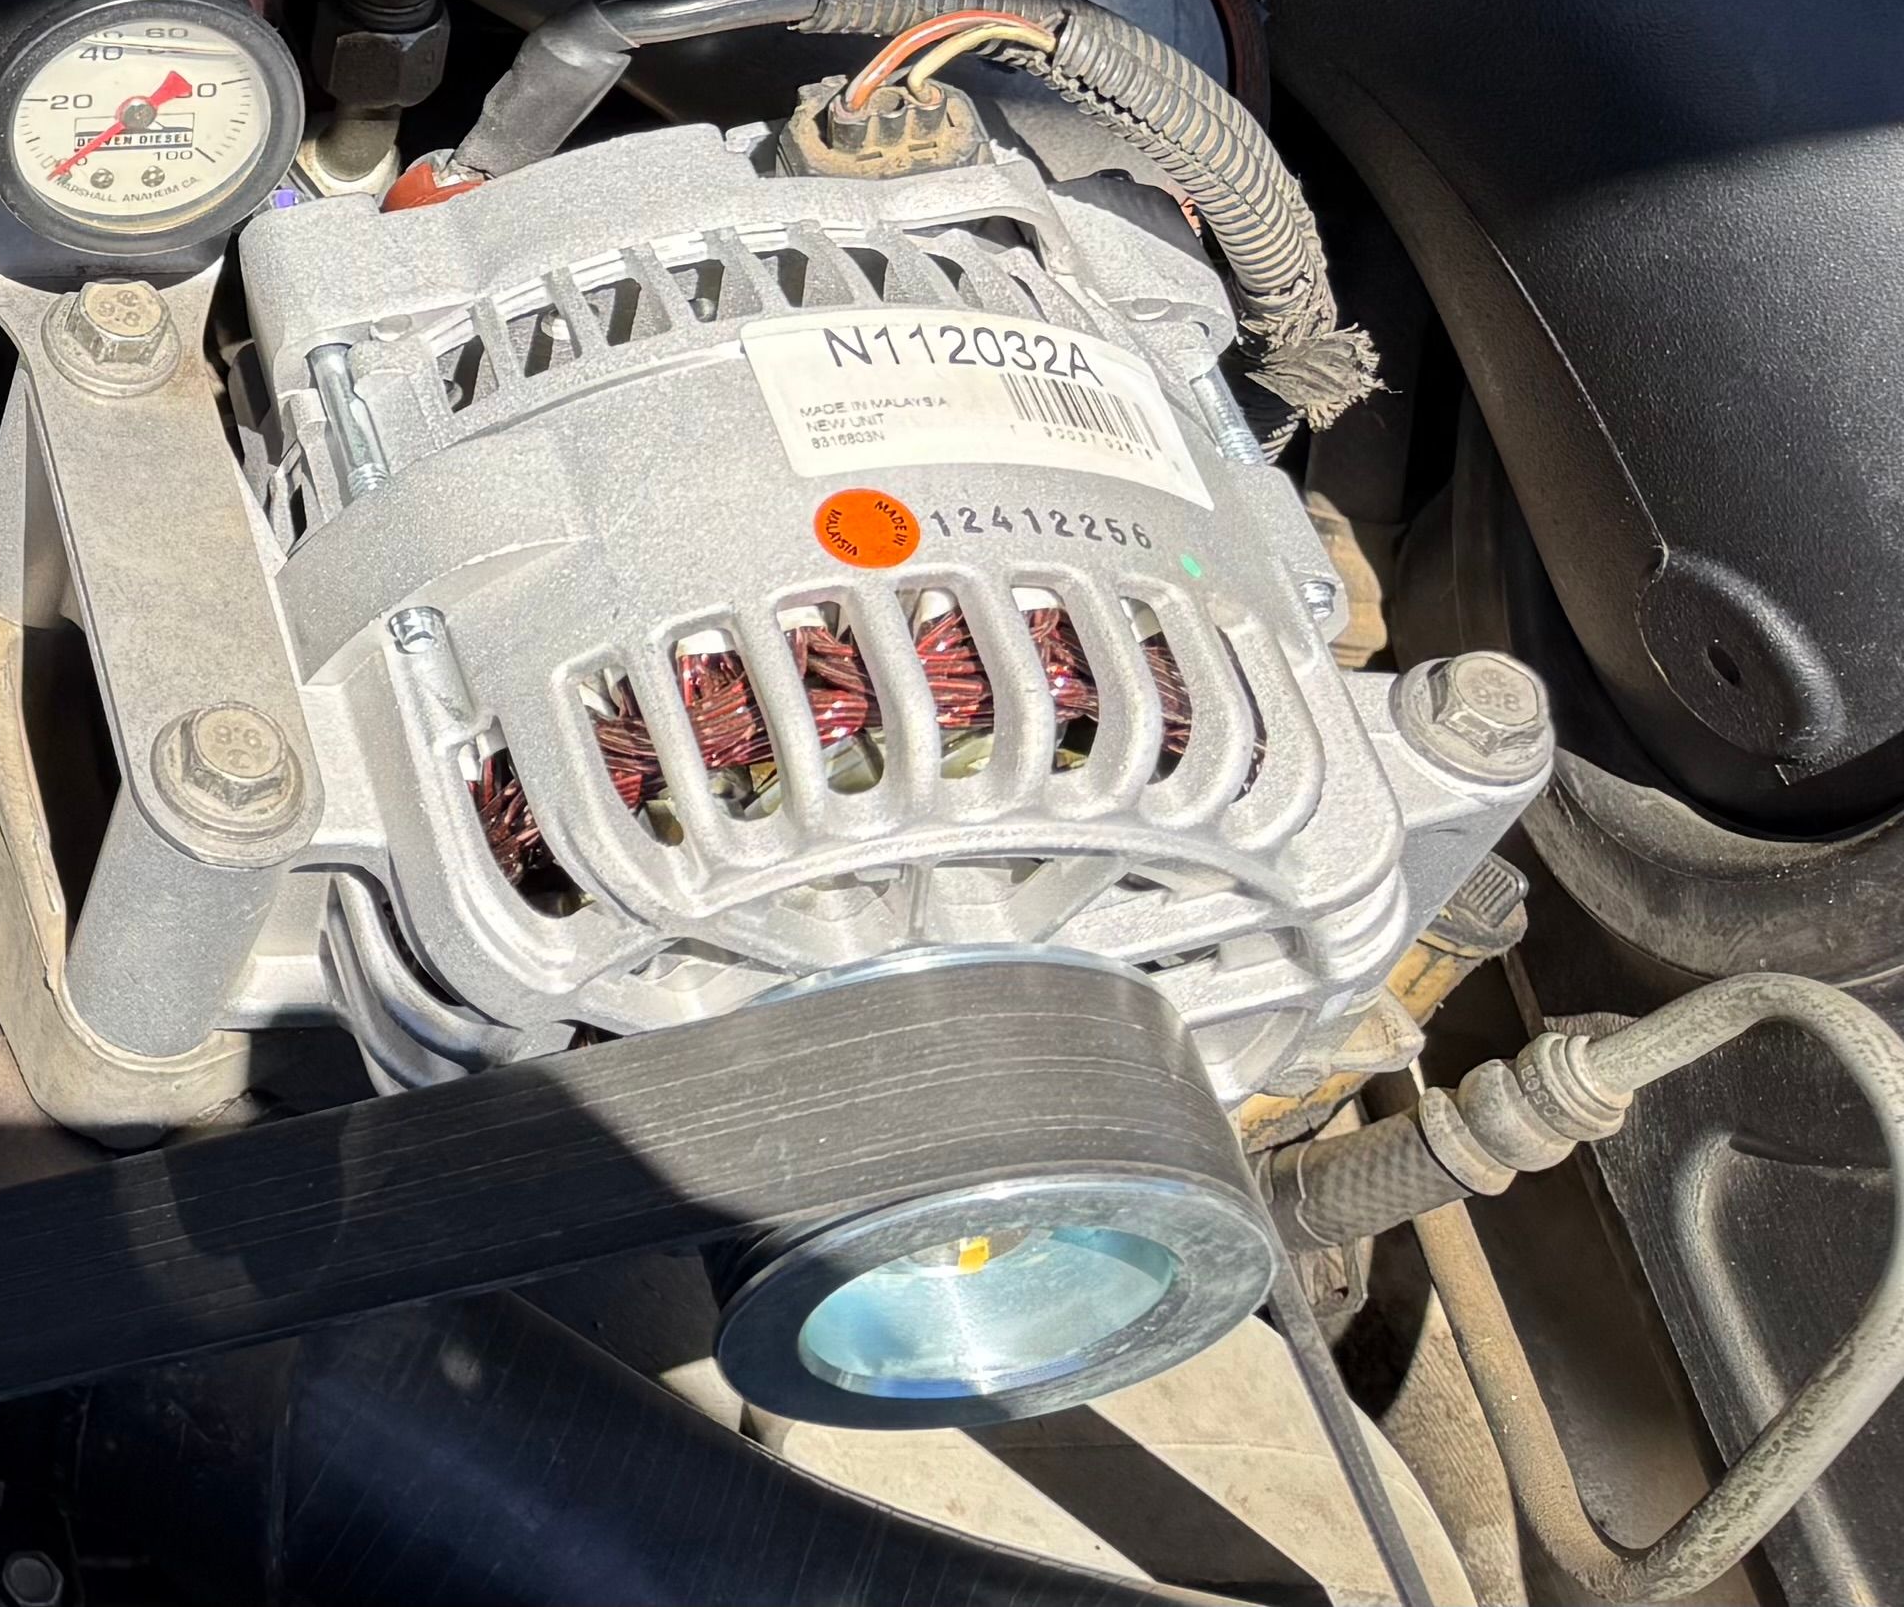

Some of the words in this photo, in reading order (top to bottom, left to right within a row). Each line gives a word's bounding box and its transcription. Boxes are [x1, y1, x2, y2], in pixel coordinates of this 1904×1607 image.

[145, 27, 189, 39] 60
[79, 45, 124, 61] 40
[49, 94, 93, 110] 20
[139, 133, 191, 145] DIESEL
[153, 150, 193, 161] 100
[823, 323, 1103, 387] N112032A
[799, 402, 848, 417] MADE
[851, 400, 867, 412] IN
[870, 396, 951, 409] MALAYSIA
[806, 418, 846, 433] NEW
[849, 412, 885, 428] UNIT
[874, 500, 907, 531] MADE
[825, 508, 858, 556] MALAYSIA
[930, 505, 1152, 551] 12412256
